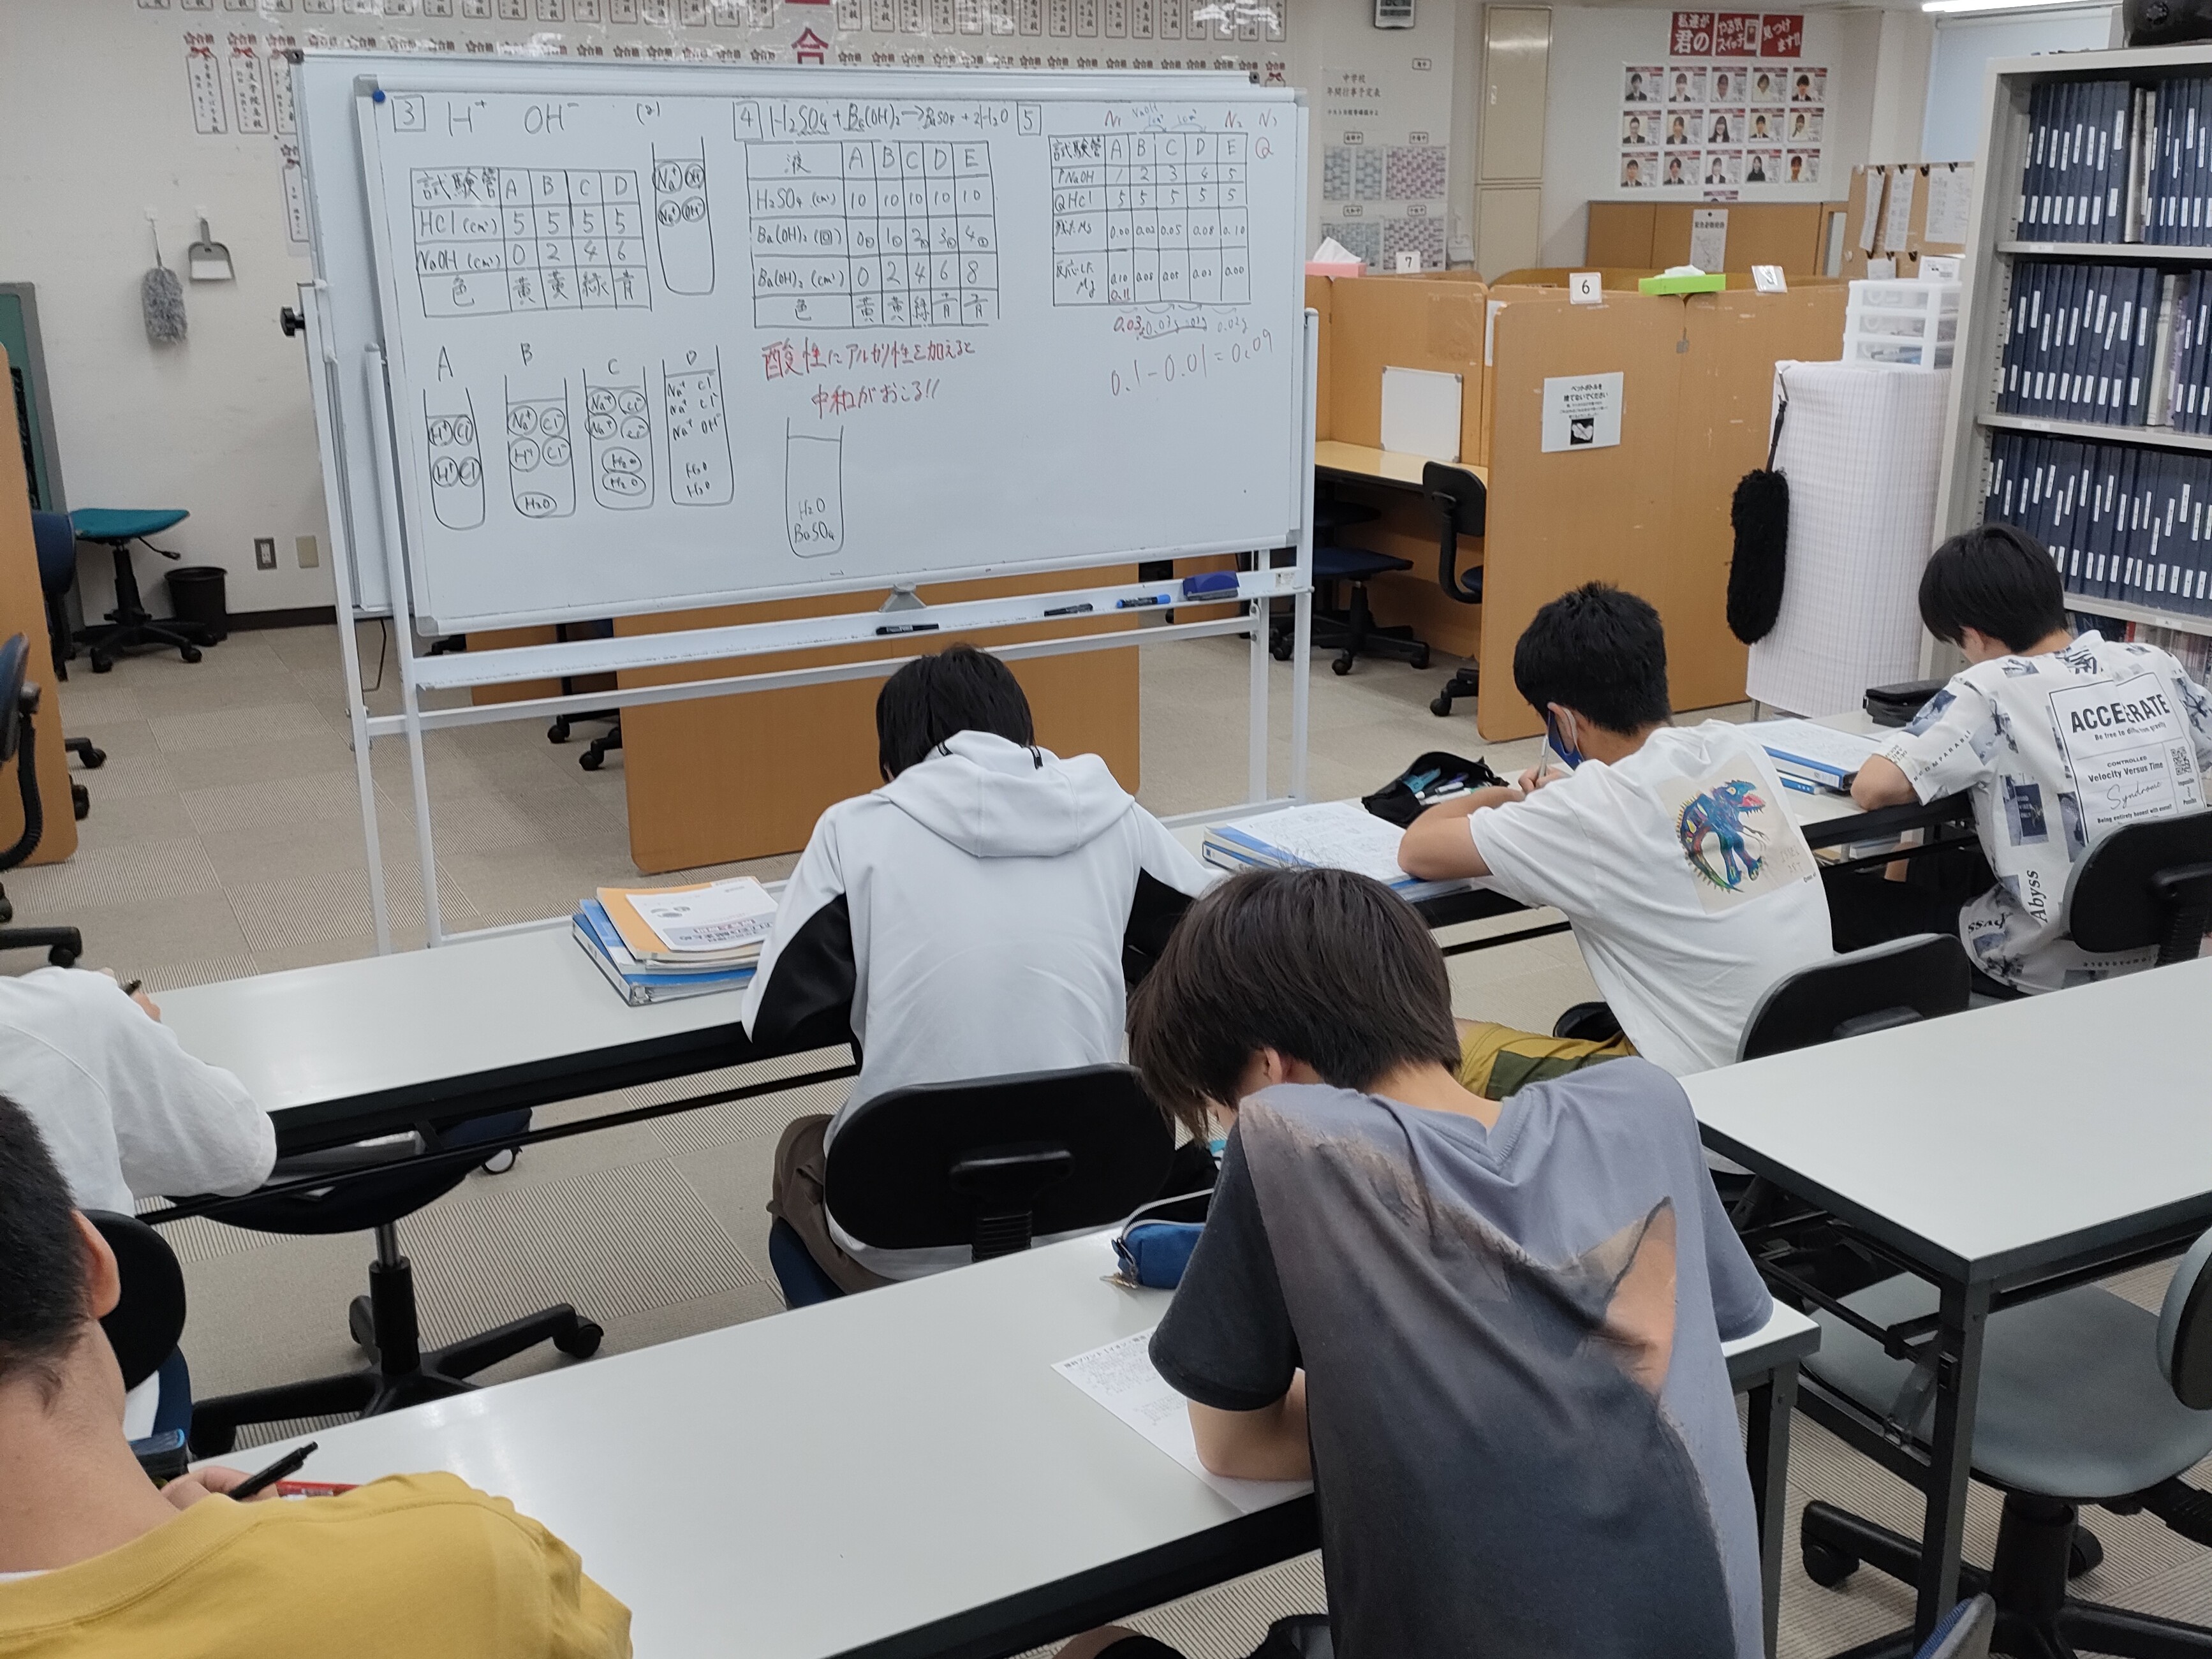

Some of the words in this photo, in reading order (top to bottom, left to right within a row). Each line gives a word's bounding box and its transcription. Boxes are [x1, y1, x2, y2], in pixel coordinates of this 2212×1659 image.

[1674, 30, 1709, 54] 君の
[403, 100, 415, 126] 3
[740, 107, 754, 129] 4
[1022, 109, 1033, 131] 5
[849, 147, 864, 170] A
[883, 146, 895, 168] B
[906, 150, 918, 170] C
[934, 148, 947, 170] D
[965, 149, 978, 167] E
[1111, 139, 1122, 160] A
[1137, 138, 1146, 157] B
[1167, 139, 1177, 156] C
[1196, 137, 1206, 155] D
[1228, 139, 1237, 155] E
[1140, 167, 1149, 182] 2
[1169, 165, 1177, 180] 3
[1228, 168, 1237, 181] 5
[506, 179, 517, 199] A
[543, 175, 554, 196] B
[580, 179, 591, 196] C
[615, 175, 628, 195] D
[1118, 189, 1126, 207] 5
[1140, 189, 1147, 207] 5
[1171, 189, 1179, 205] 5
[1199, 186, 1206, 202] 5
[1227, 188, 1237, 202] 5
[851, 194, 866, 208] 10
[884, 194, 899, 207] 10
[909, 194, 923, 207] 10
[934, 192, 950, 207] 10
[963, 189, 980, 202] 10
[513, 214, 525, 235] 5
[548, 210, 560, 235] 5
[582, 210, 594, 233] 5
[616, 208, 626, 233] 5
[513, 244, 526, 265] 0
[547, 243, 561, 261] 2
[584, 240, 598, 257] 4
[617, 240, 626, 260] 6
[1405, 257, 1412, 268] 7
[858, 266, 869, 287] 0
[887, 262, 901, 285] 2
[915, 263, 925, 284] 4
[940, 260, 948, 281] 6
[967, 261, 979, 283] 8
[1581, 279, 1590, 295] 6
[438, 345, 453, 382] A
[520, 343, 533, 366] B
[685, 349, 697, 366] D
[608, 358, 620, 375] C
[2088, 771, 2122, 783] Velocity
[2124, 766, 2148, 776] Versus
[2149, 762, 2164, 771] Time
[2107, 756, 2148, 767] CONTROLLED
[2113, 812, 2132, 822] entirely
[2134, 809, 2149, 817] honest
[2026, 870, 2048, 923] Abyss
